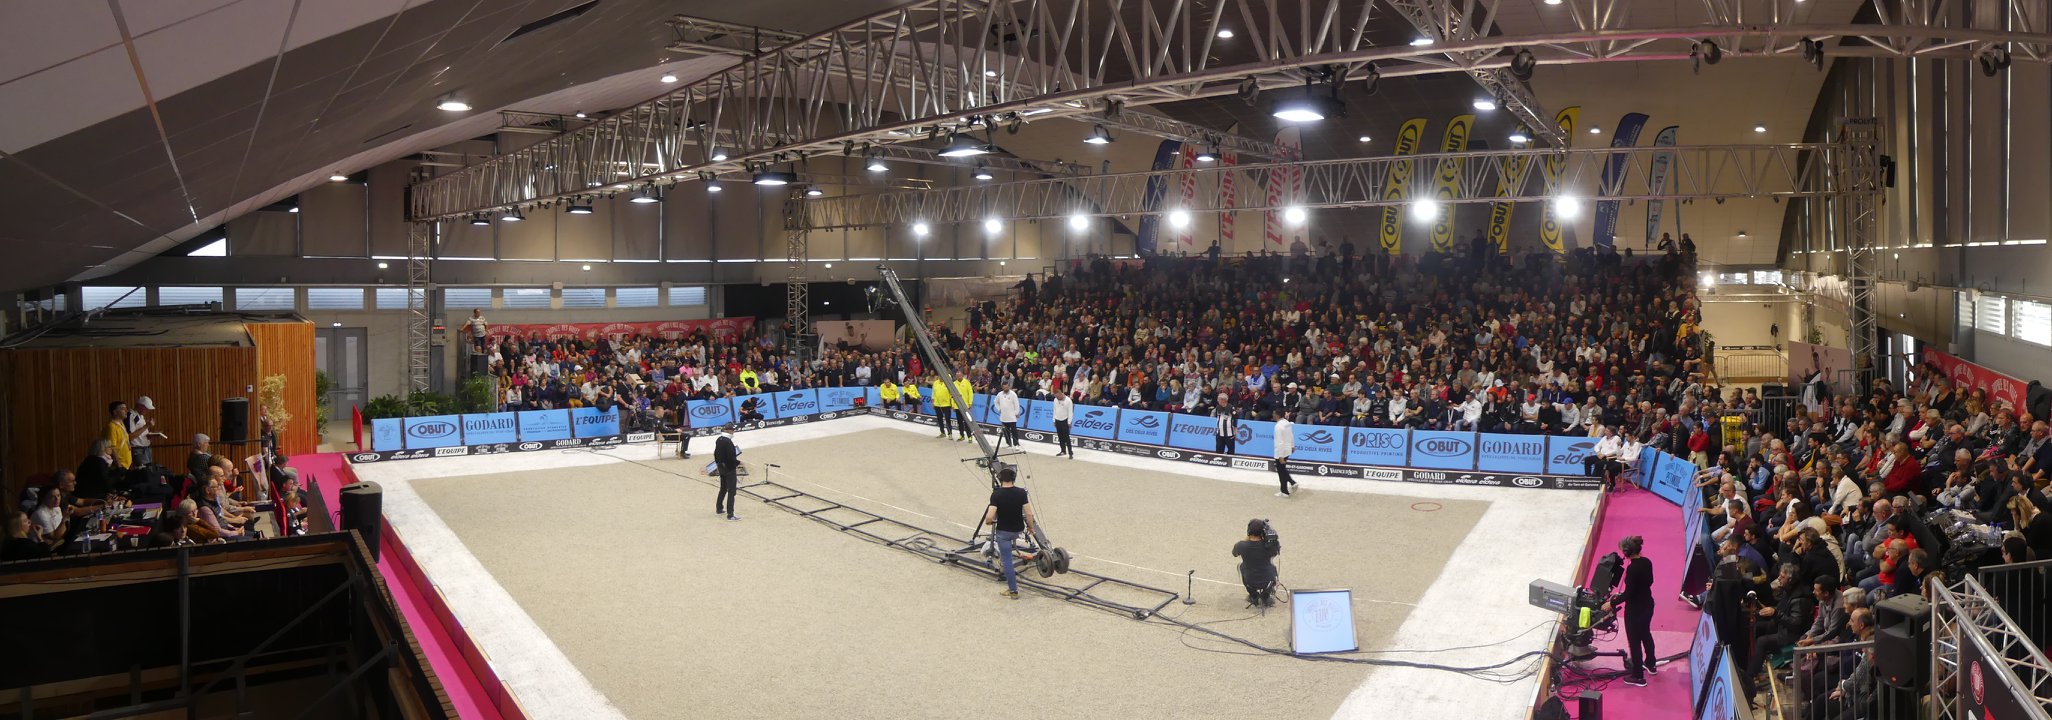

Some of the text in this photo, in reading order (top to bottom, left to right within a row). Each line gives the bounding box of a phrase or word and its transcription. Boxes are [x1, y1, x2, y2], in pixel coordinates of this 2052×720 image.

[698, 405, 721, 416] OBUT
[780, 401, 816, 412] eldera
[417, 423, 447, 435] OBUT
[465, 417, 514, 432] GODARD
[1073, 418, 1114, 431] eldera
[555, 438, 582, 447] GODARD
[1365, 432, 1404, 449] RISO
[1426, 440, 1460, 453] OBUT
[1482, 440, 1542, 456] GODARD
[1413, 471, 1446, 480] GODARD
[1518, 477, 1537, 486] OBUT
